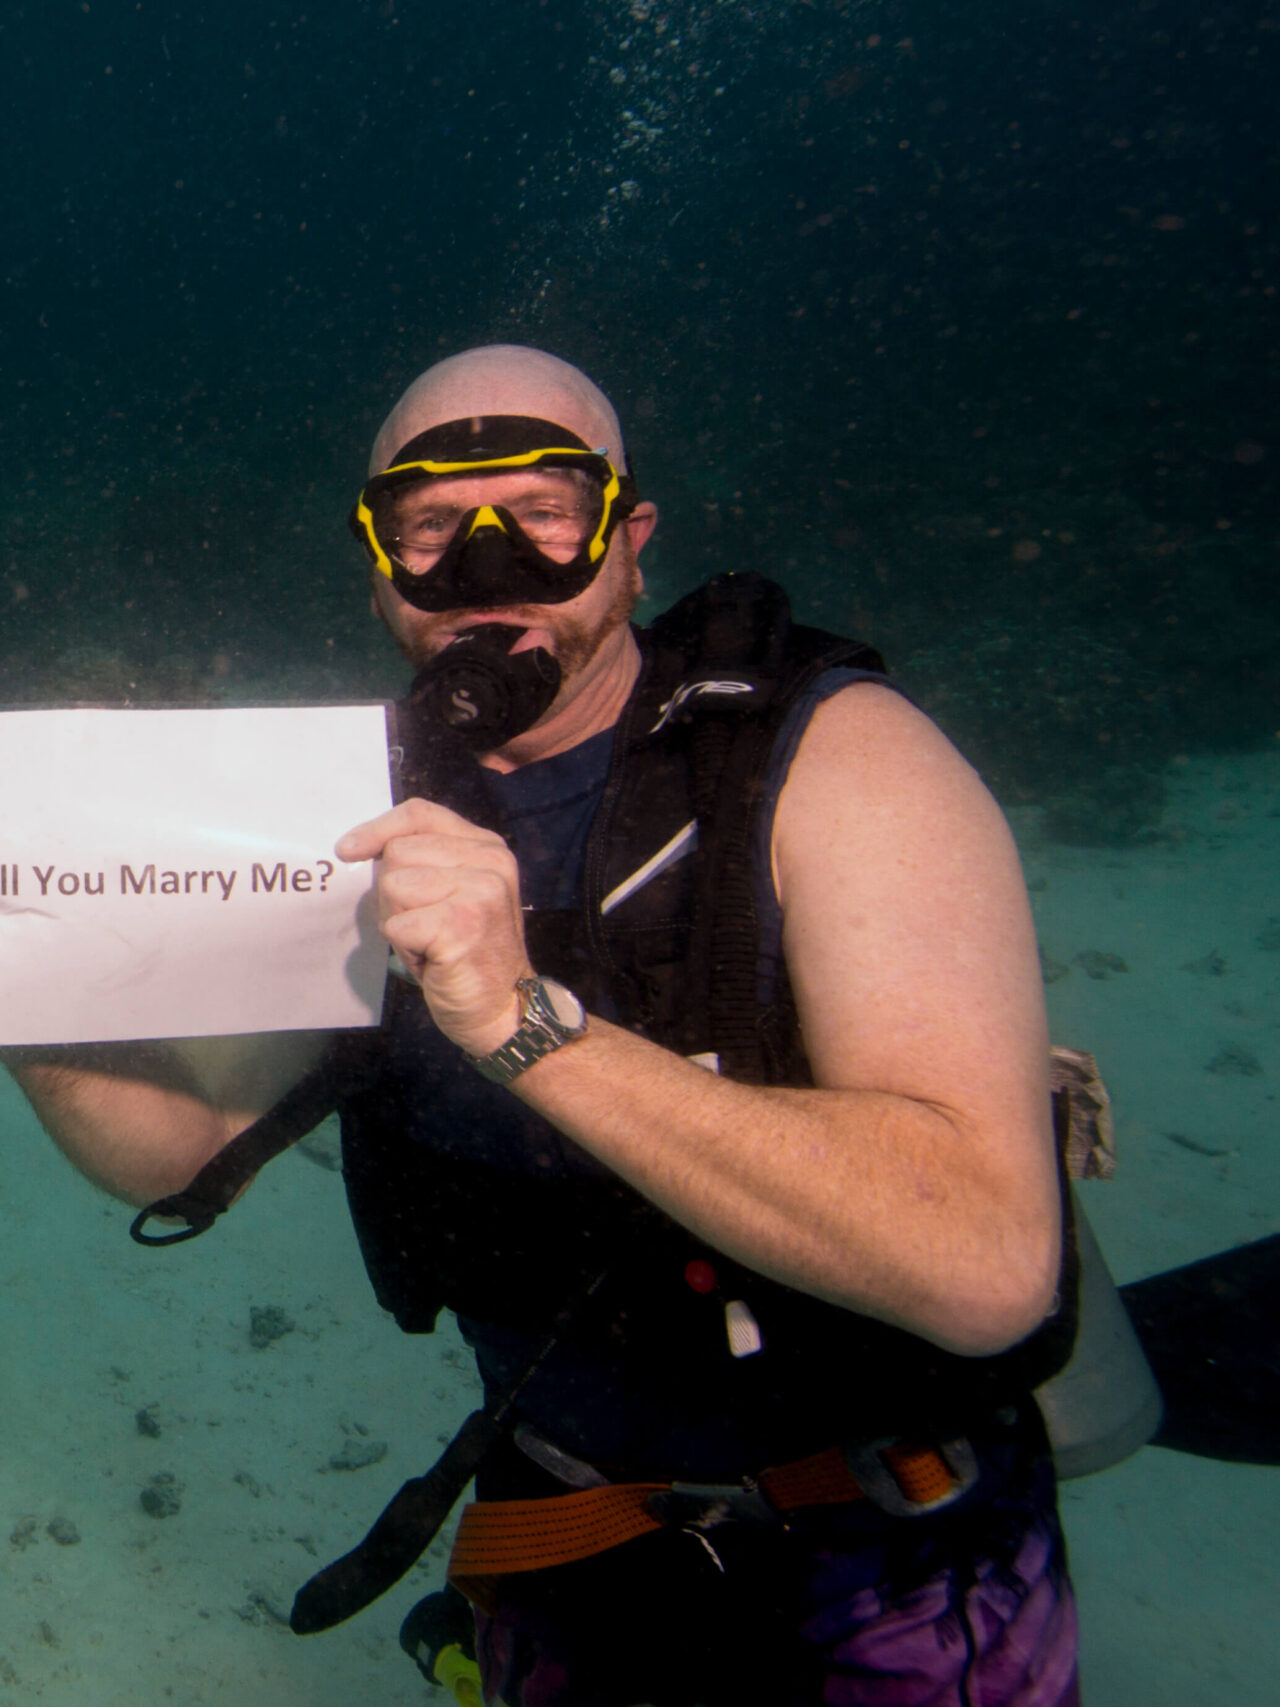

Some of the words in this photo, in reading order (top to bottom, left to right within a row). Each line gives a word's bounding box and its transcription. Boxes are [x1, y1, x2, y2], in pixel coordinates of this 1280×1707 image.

[33, 865, 106, 896] You
[120, 864, 237, 901] Marry
[251, 860, 335, 893] Me?
